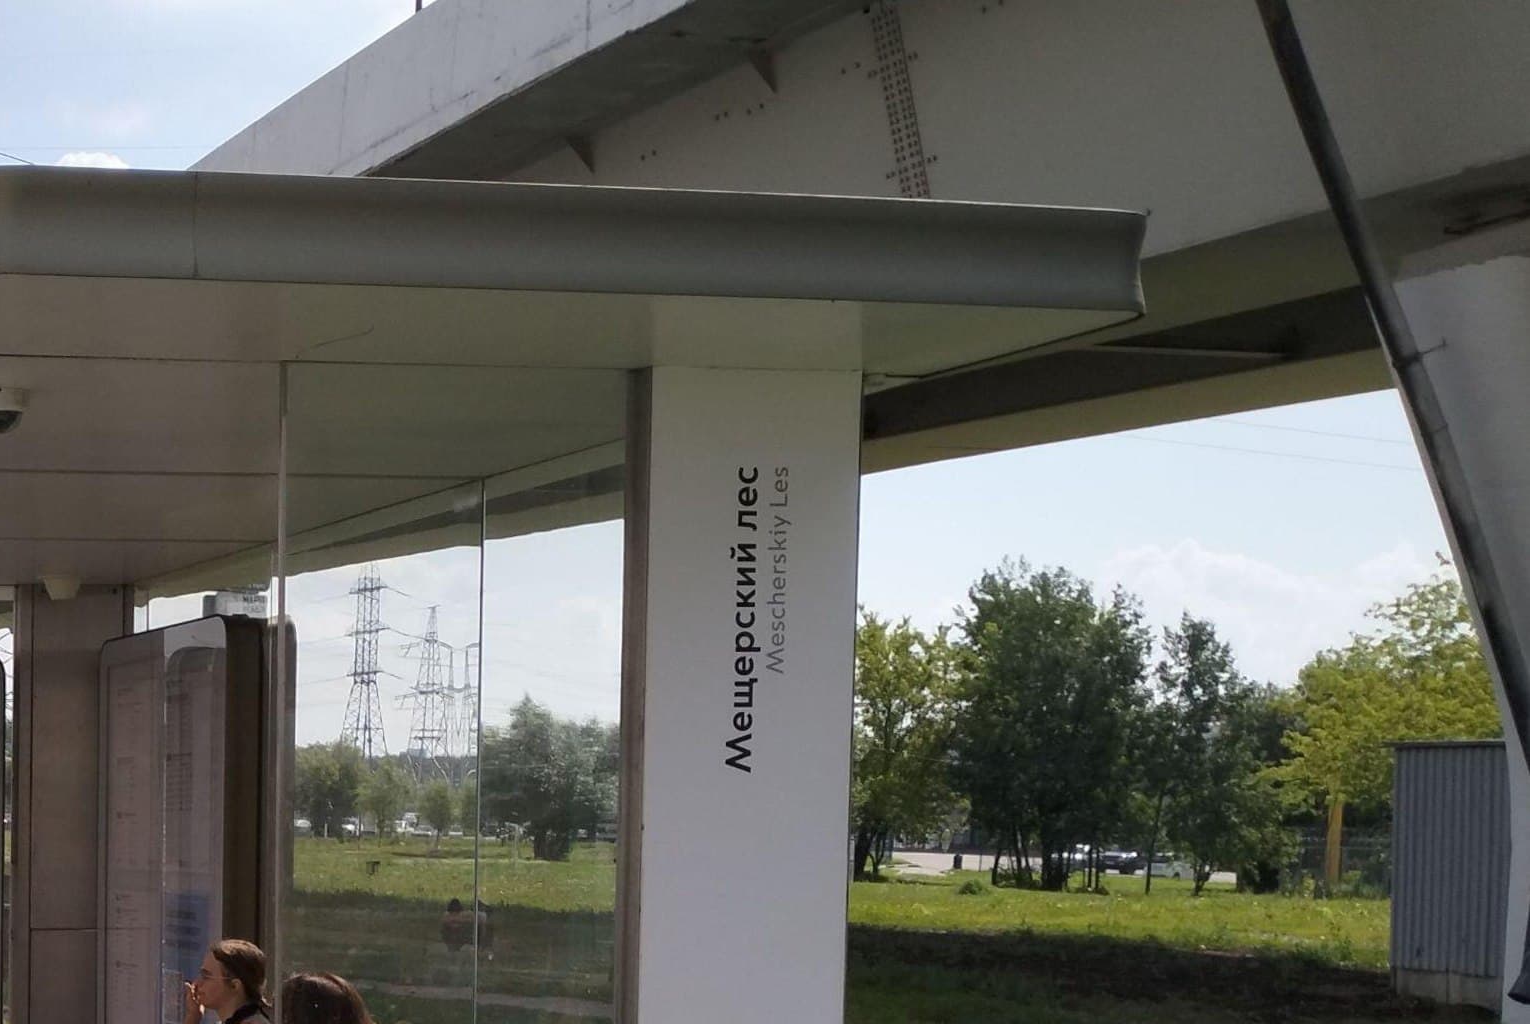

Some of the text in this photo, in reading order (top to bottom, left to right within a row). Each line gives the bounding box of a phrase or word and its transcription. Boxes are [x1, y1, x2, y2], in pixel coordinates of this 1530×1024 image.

[725, 466, 761, 774] Мещерский лес
[765, 466, 792, 675] Mescherskiy Les
